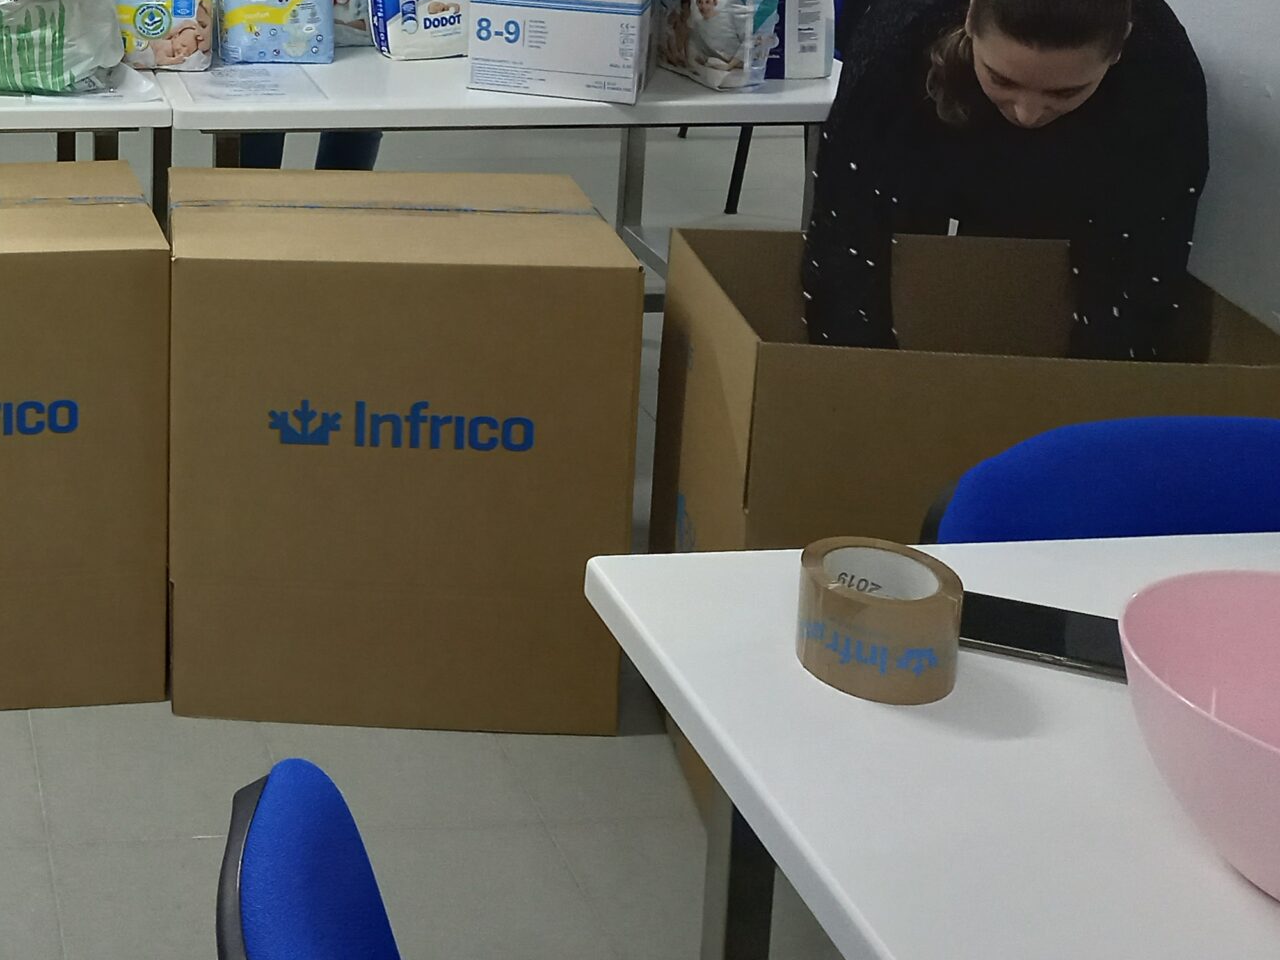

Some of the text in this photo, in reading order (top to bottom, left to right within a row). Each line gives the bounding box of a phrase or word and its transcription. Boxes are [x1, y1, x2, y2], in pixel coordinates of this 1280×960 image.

[423, 14, 462, 30] DODOT
[476, 18, 521, 44] 8-9
[354, 401, 534, 452] Infrico
[836, 572, 883, 593] 2019
